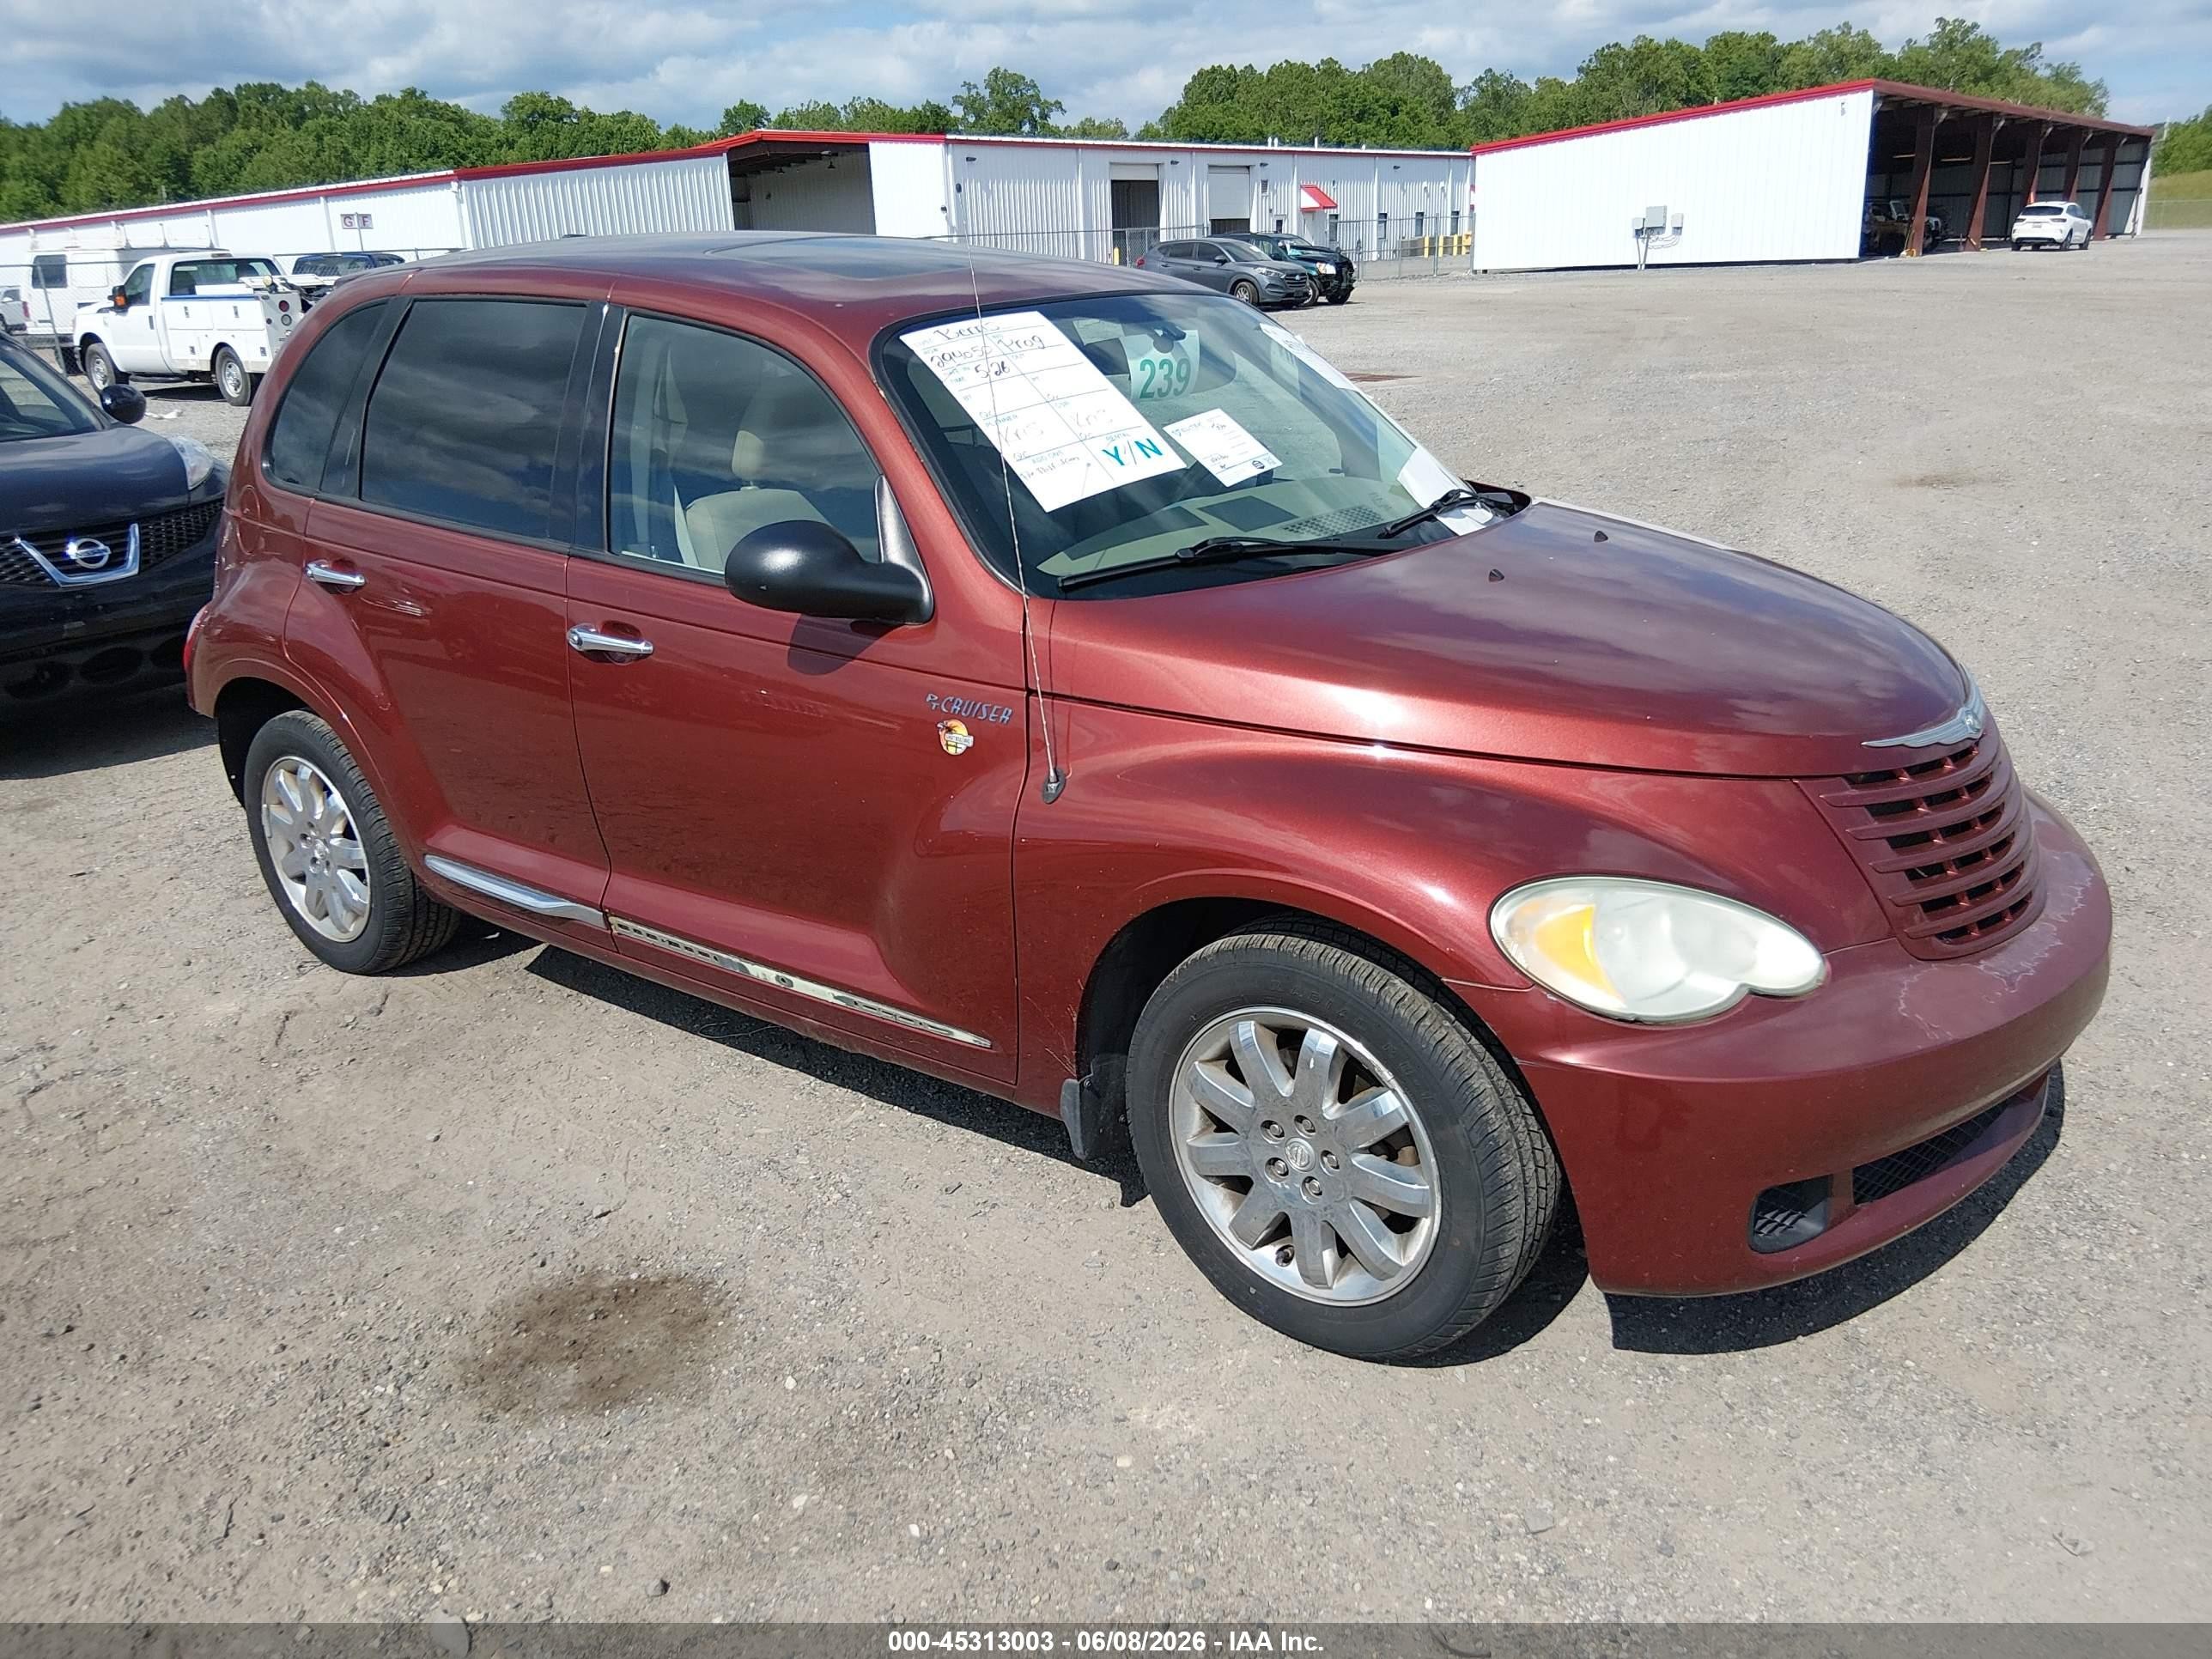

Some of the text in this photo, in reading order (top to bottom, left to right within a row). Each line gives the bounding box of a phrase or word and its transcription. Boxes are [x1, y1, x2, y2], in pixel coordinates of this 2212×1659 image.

[343, 216, 370, 228] G F
[1139, 357, 1191, 399] 239
[1102, 437, 1164, 466] Y/N
[926, 693, 1012, 725] PT CRUISER
